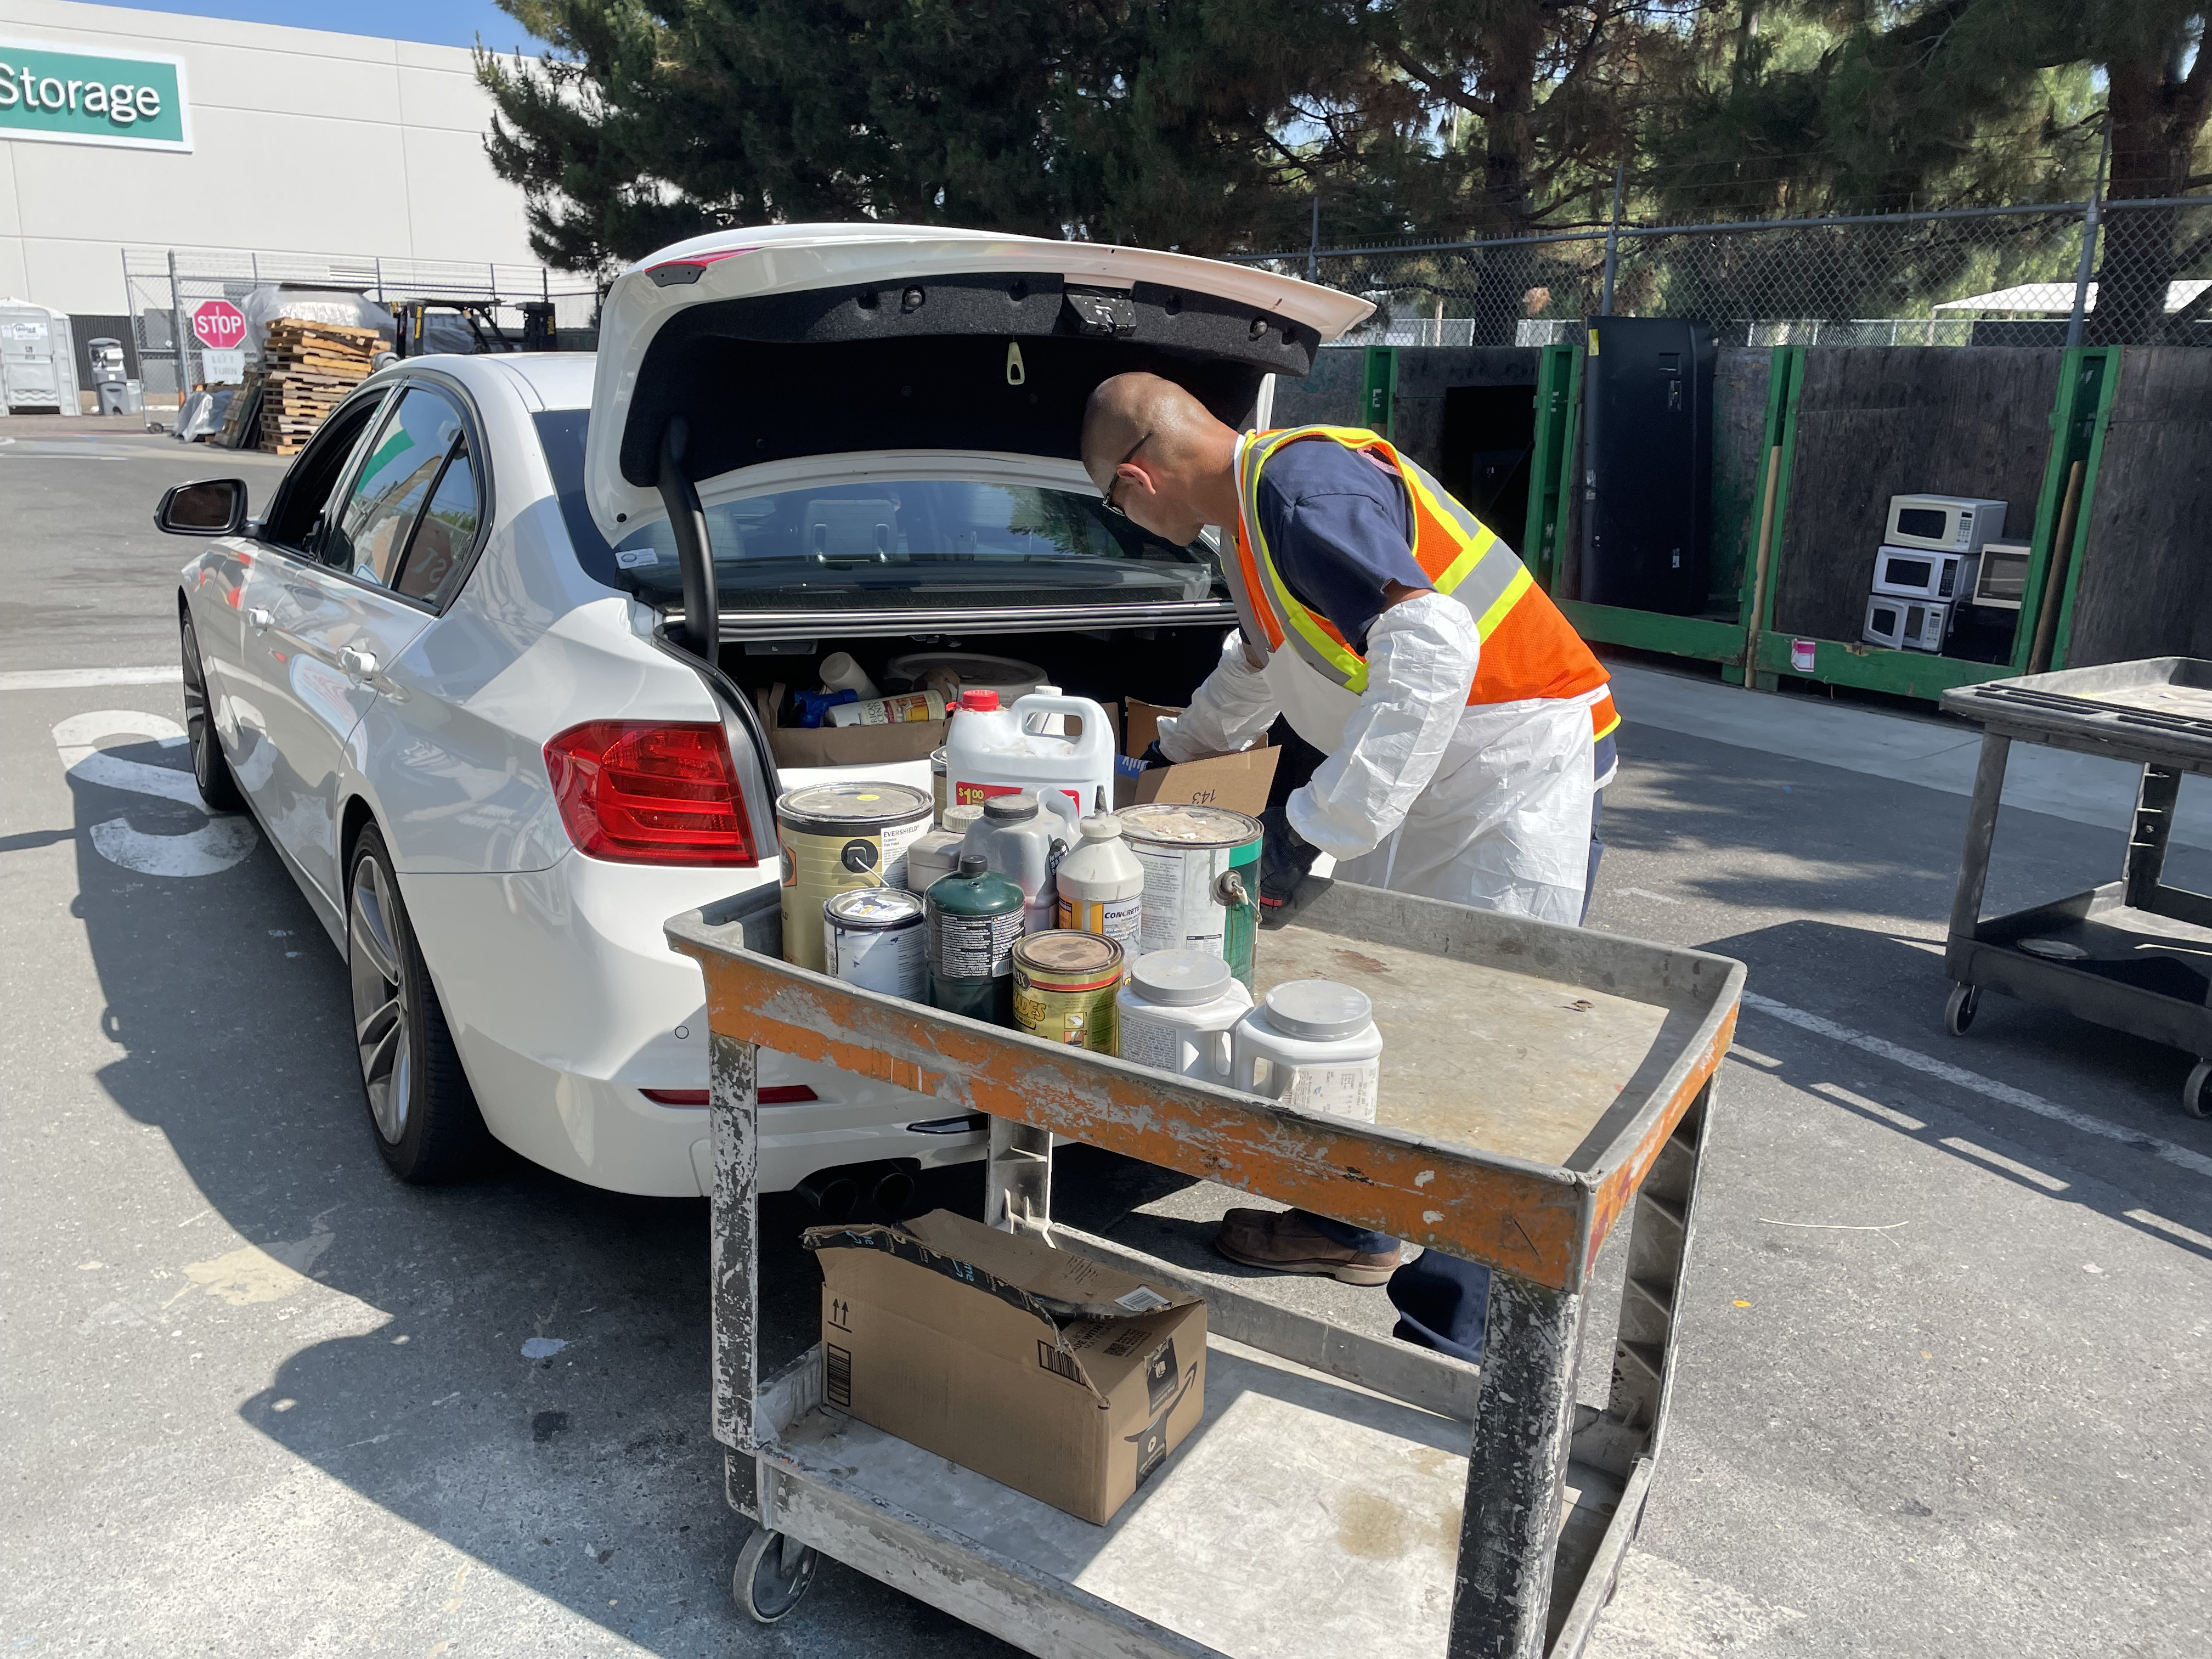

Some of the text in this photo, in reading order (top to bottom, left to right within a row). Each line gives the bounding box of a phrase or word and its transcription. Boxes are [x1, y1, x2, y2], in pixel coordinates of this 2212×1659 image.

[0, 62, 161, 122] Storage
[198, 315, 241, 334] STOP
[866, 702, 878, 724] RICAN
[1104, 904, 1140, 919] CONCRETE
